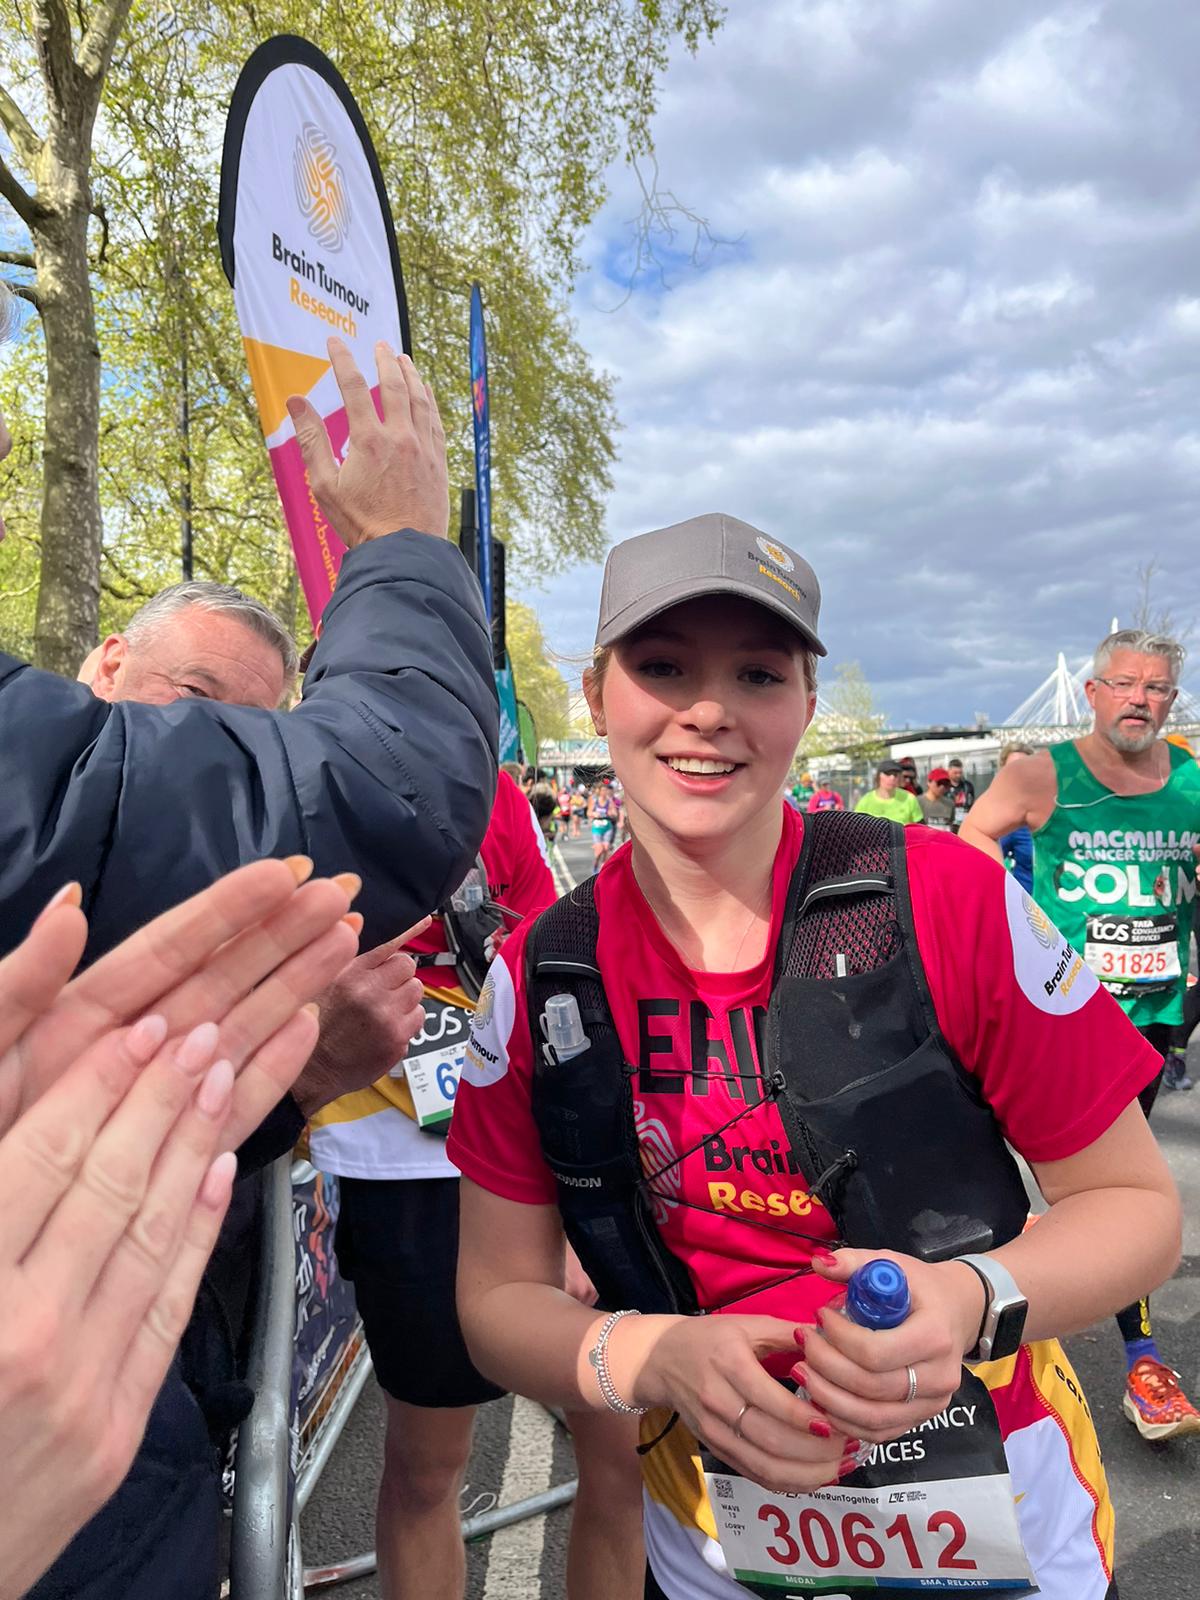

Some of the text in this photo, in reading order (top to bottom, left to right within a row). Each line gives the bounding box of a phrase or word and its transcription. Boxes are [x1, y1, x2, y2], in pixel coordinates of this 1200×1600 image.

[272, 232, 369, 316] Brain Tumour
[290, 277, 356, 338] Research
[1074, 849, 1194, 863] CANCER SUPPOR
[1102, 952, 1166, 974] 31825
[707, 1181, 823, 1216] Rese
[863, 1440, 926, 1467] VICES
[757, 1503, 978, 1570] 30612
[785, 1575, 816, 1586] MEDAL
[920, 1579, 990, 1588] SMA, RELAXED
